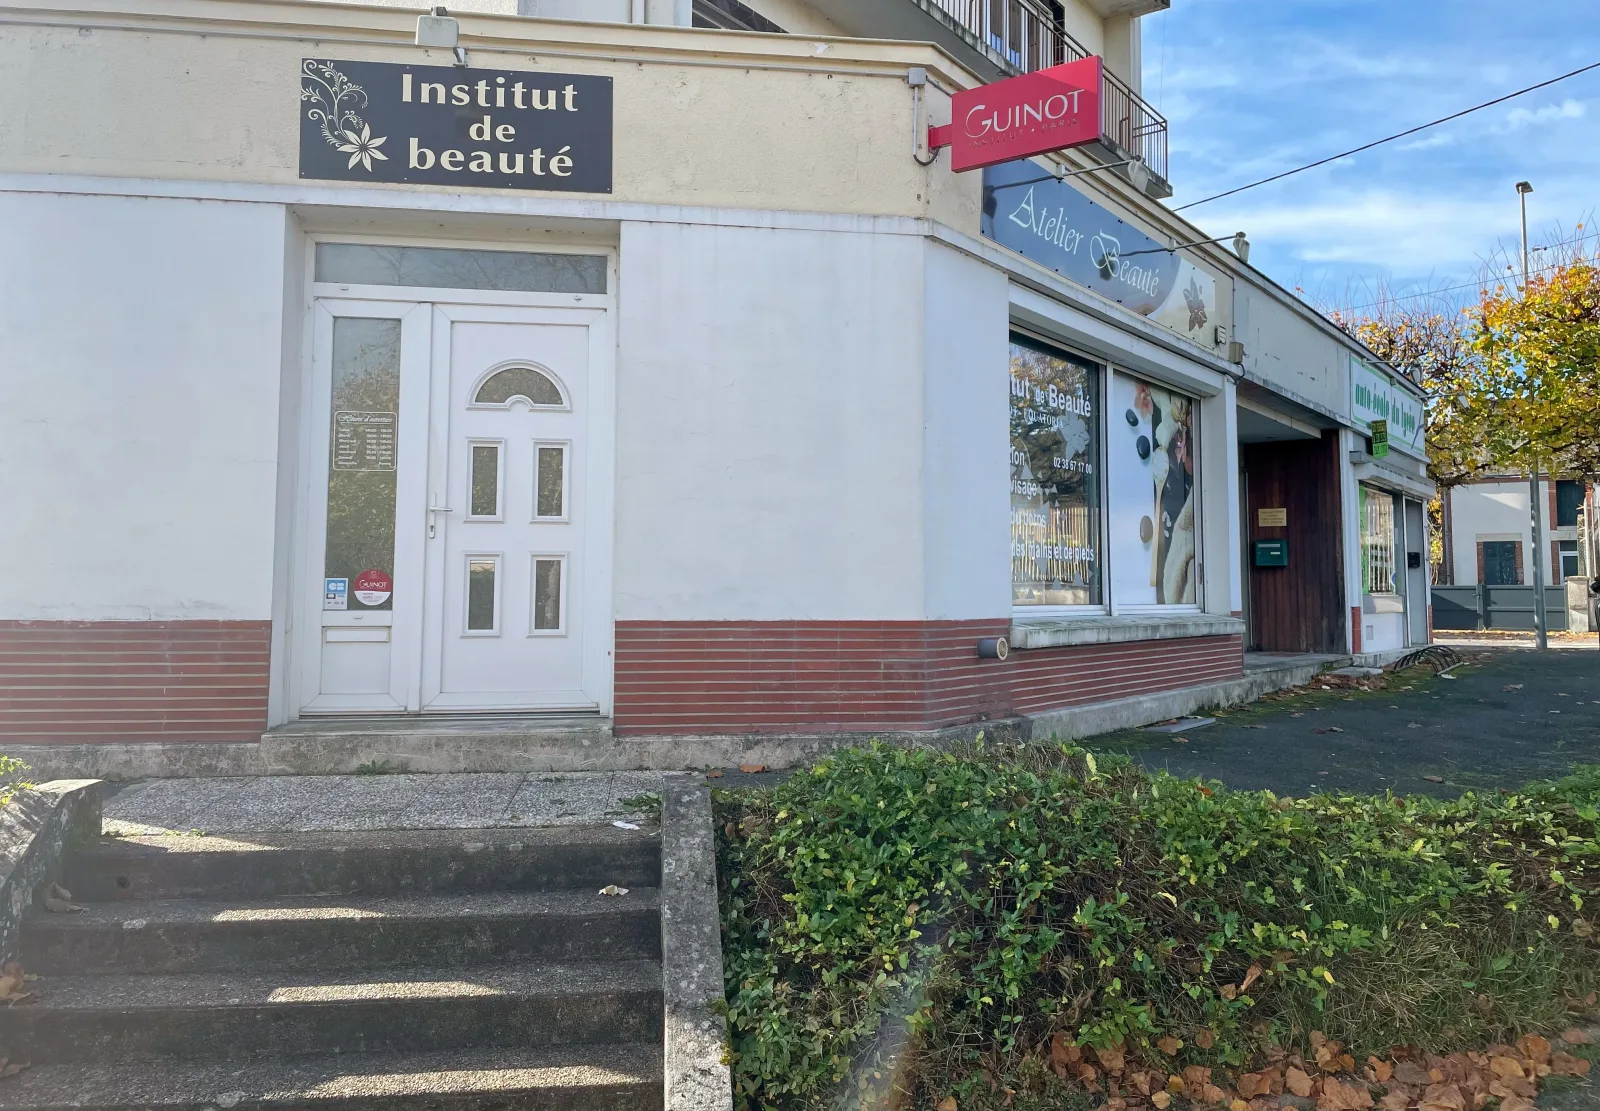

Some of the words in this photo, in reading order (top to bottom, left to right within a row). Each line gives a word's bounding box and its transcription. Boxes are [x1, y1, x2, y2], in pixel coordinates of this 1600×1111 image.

[402, 73, 578, 111] Institut
[469, 115, 516, 143] de
[965, 89, 1085, 138] GUINOT
[408, 137, 574, 177] beauté
[1008, 186, 1084, 255] Atelier
[1090, 230, 1159, 297] Beauté
[1049, 384, 1091, 417] Beauté
[1053, 456, 1061, 468] 02
[1075, 544, 1094, 564] pieds
